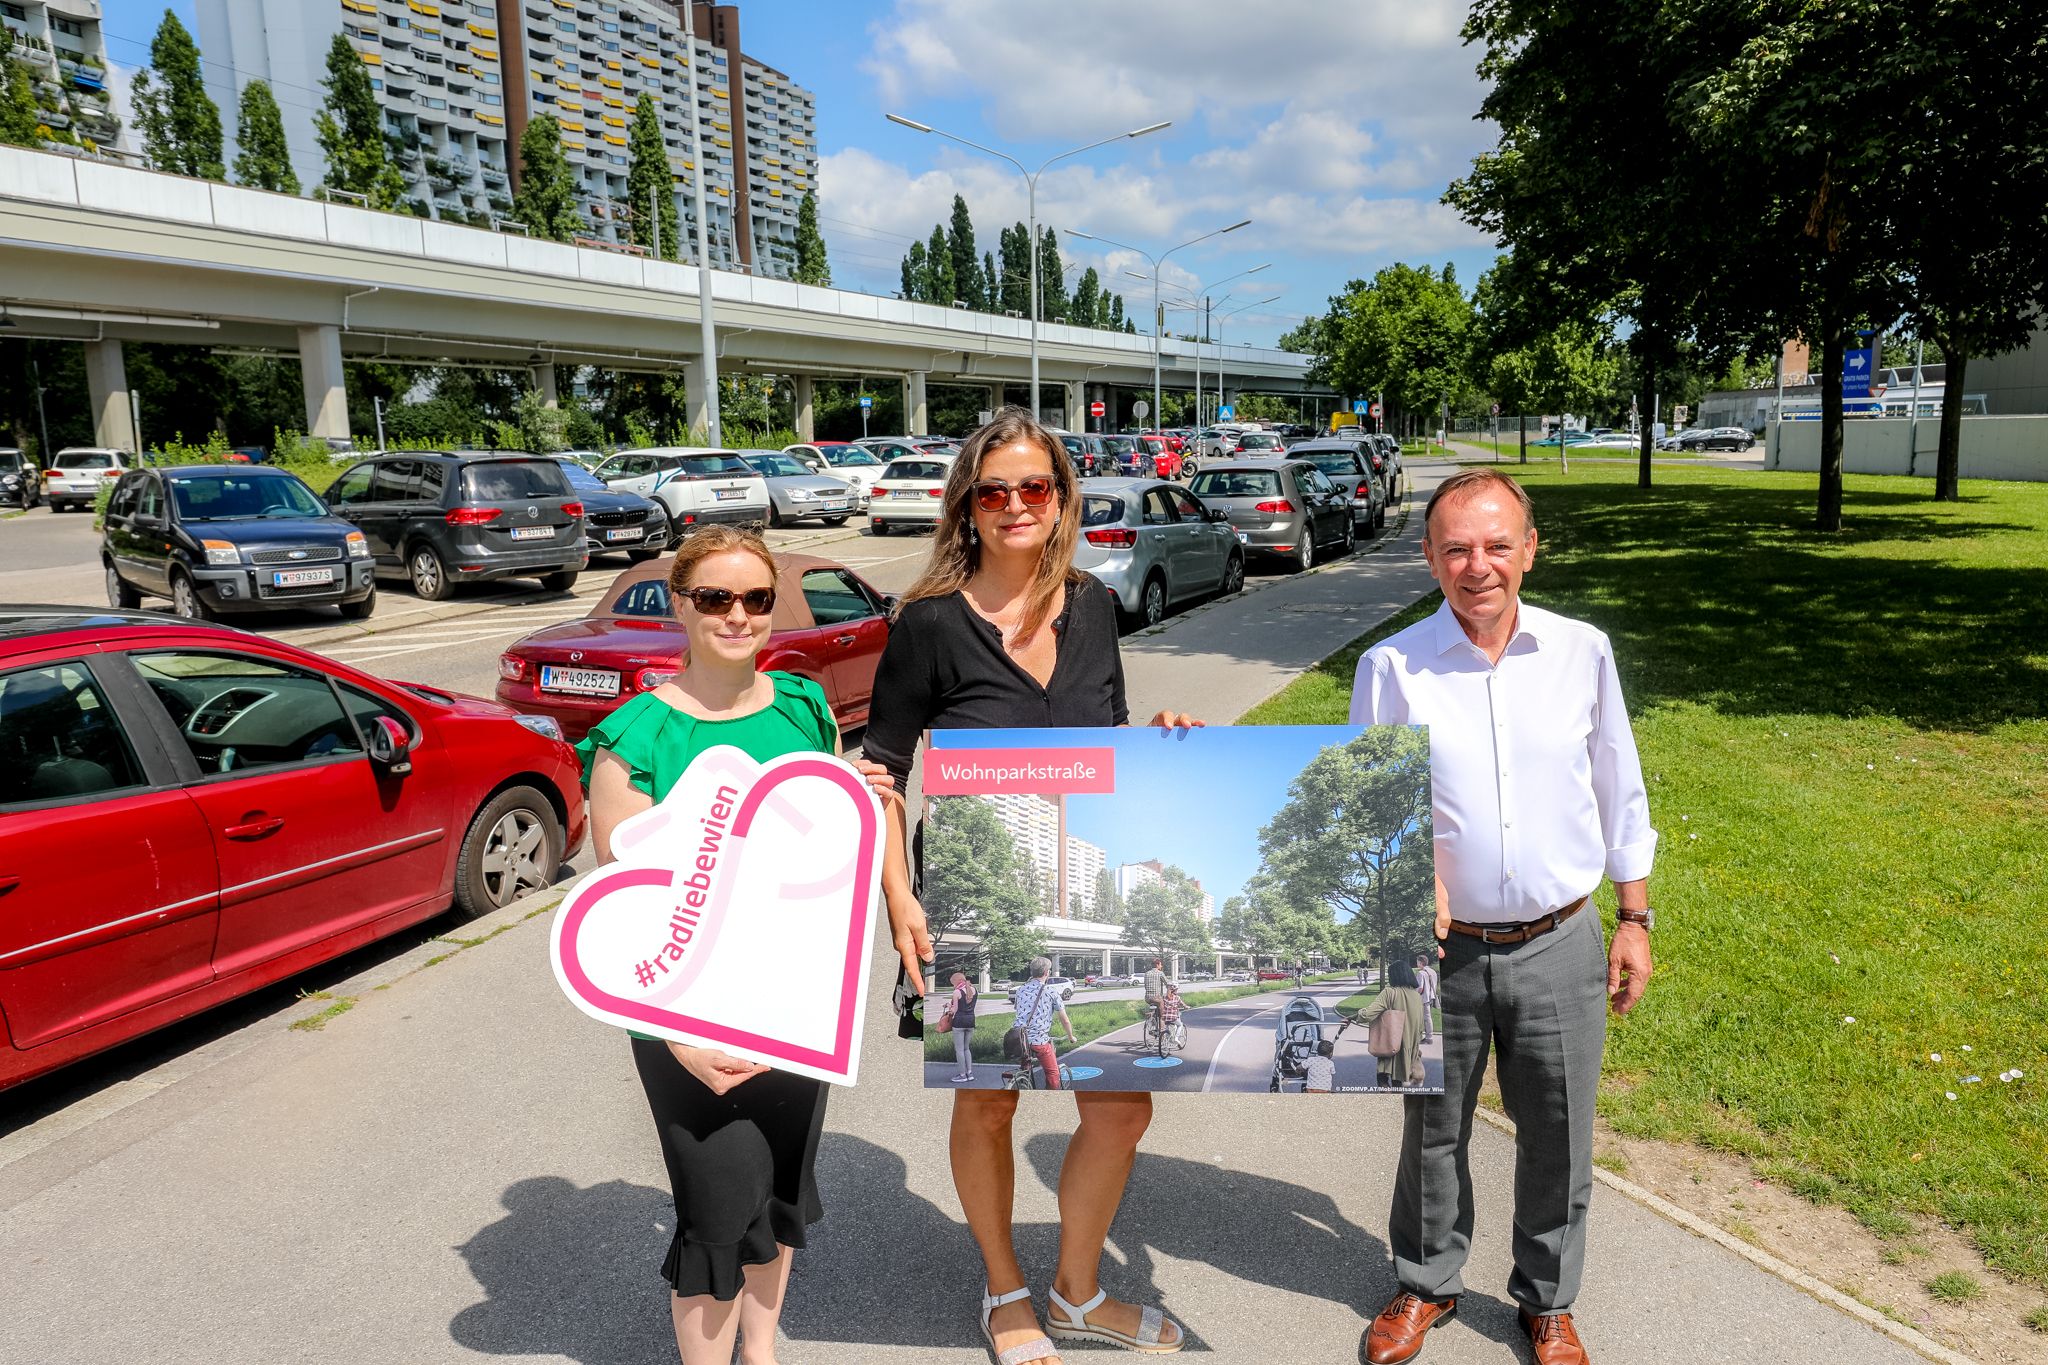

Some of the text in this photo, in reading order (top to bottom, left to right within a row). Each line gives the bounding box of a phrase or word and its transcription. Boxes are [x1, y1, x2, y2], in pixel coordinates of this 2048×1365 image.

[552, 669, 616, 690] W 49252 Z
[940, 761, 1097, 785] Wohnparkstraße
[634, 784, 739, 989] #radliebewien
